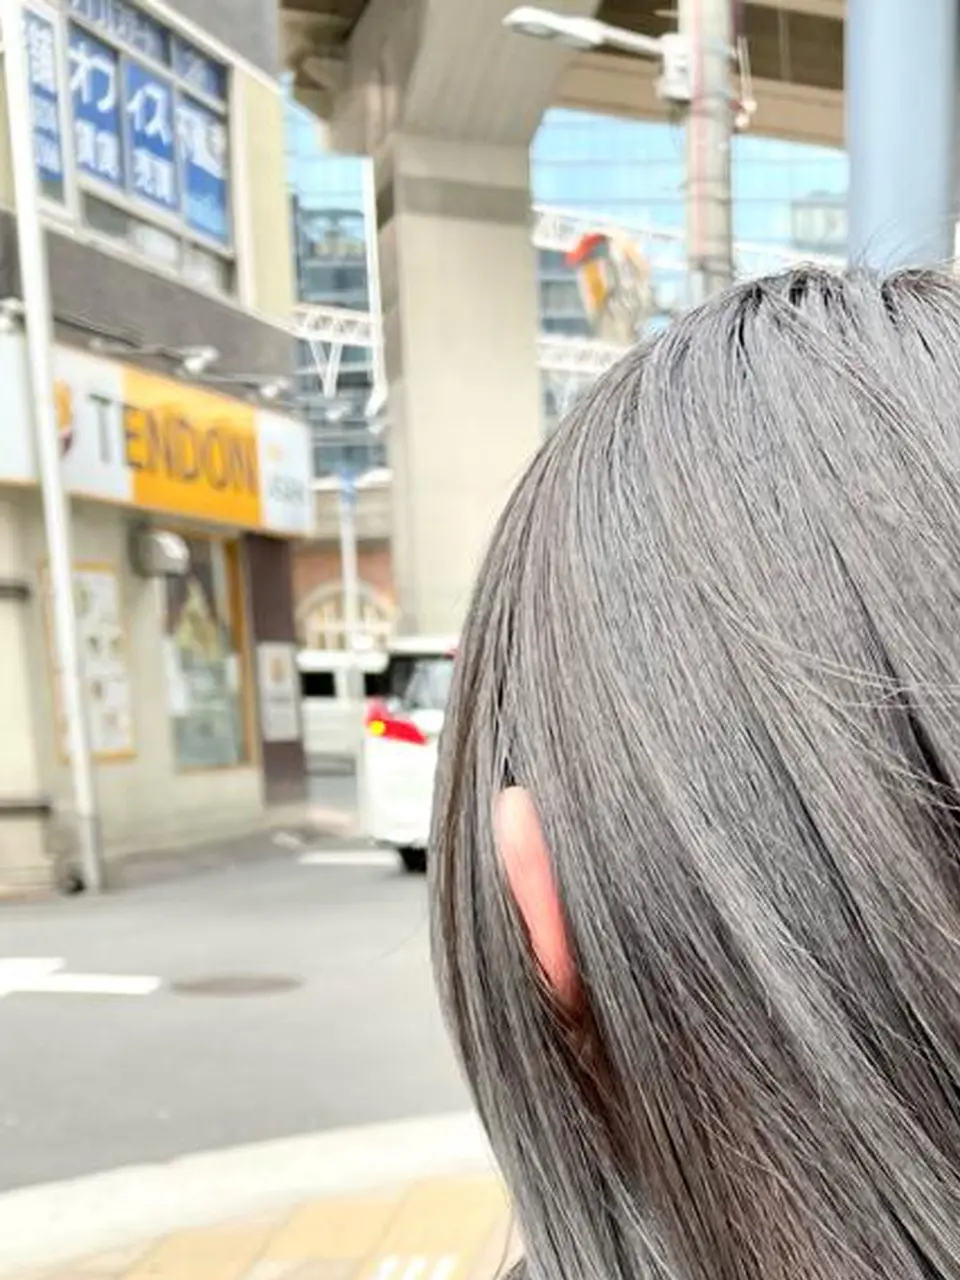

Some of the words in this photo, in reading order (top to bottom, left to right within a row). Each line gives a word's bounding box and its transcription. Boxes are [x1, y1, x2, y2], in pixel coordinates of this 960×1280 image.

[68, 42, 173, 146] オフィス
[89, 393, 258, 494] TENDON
